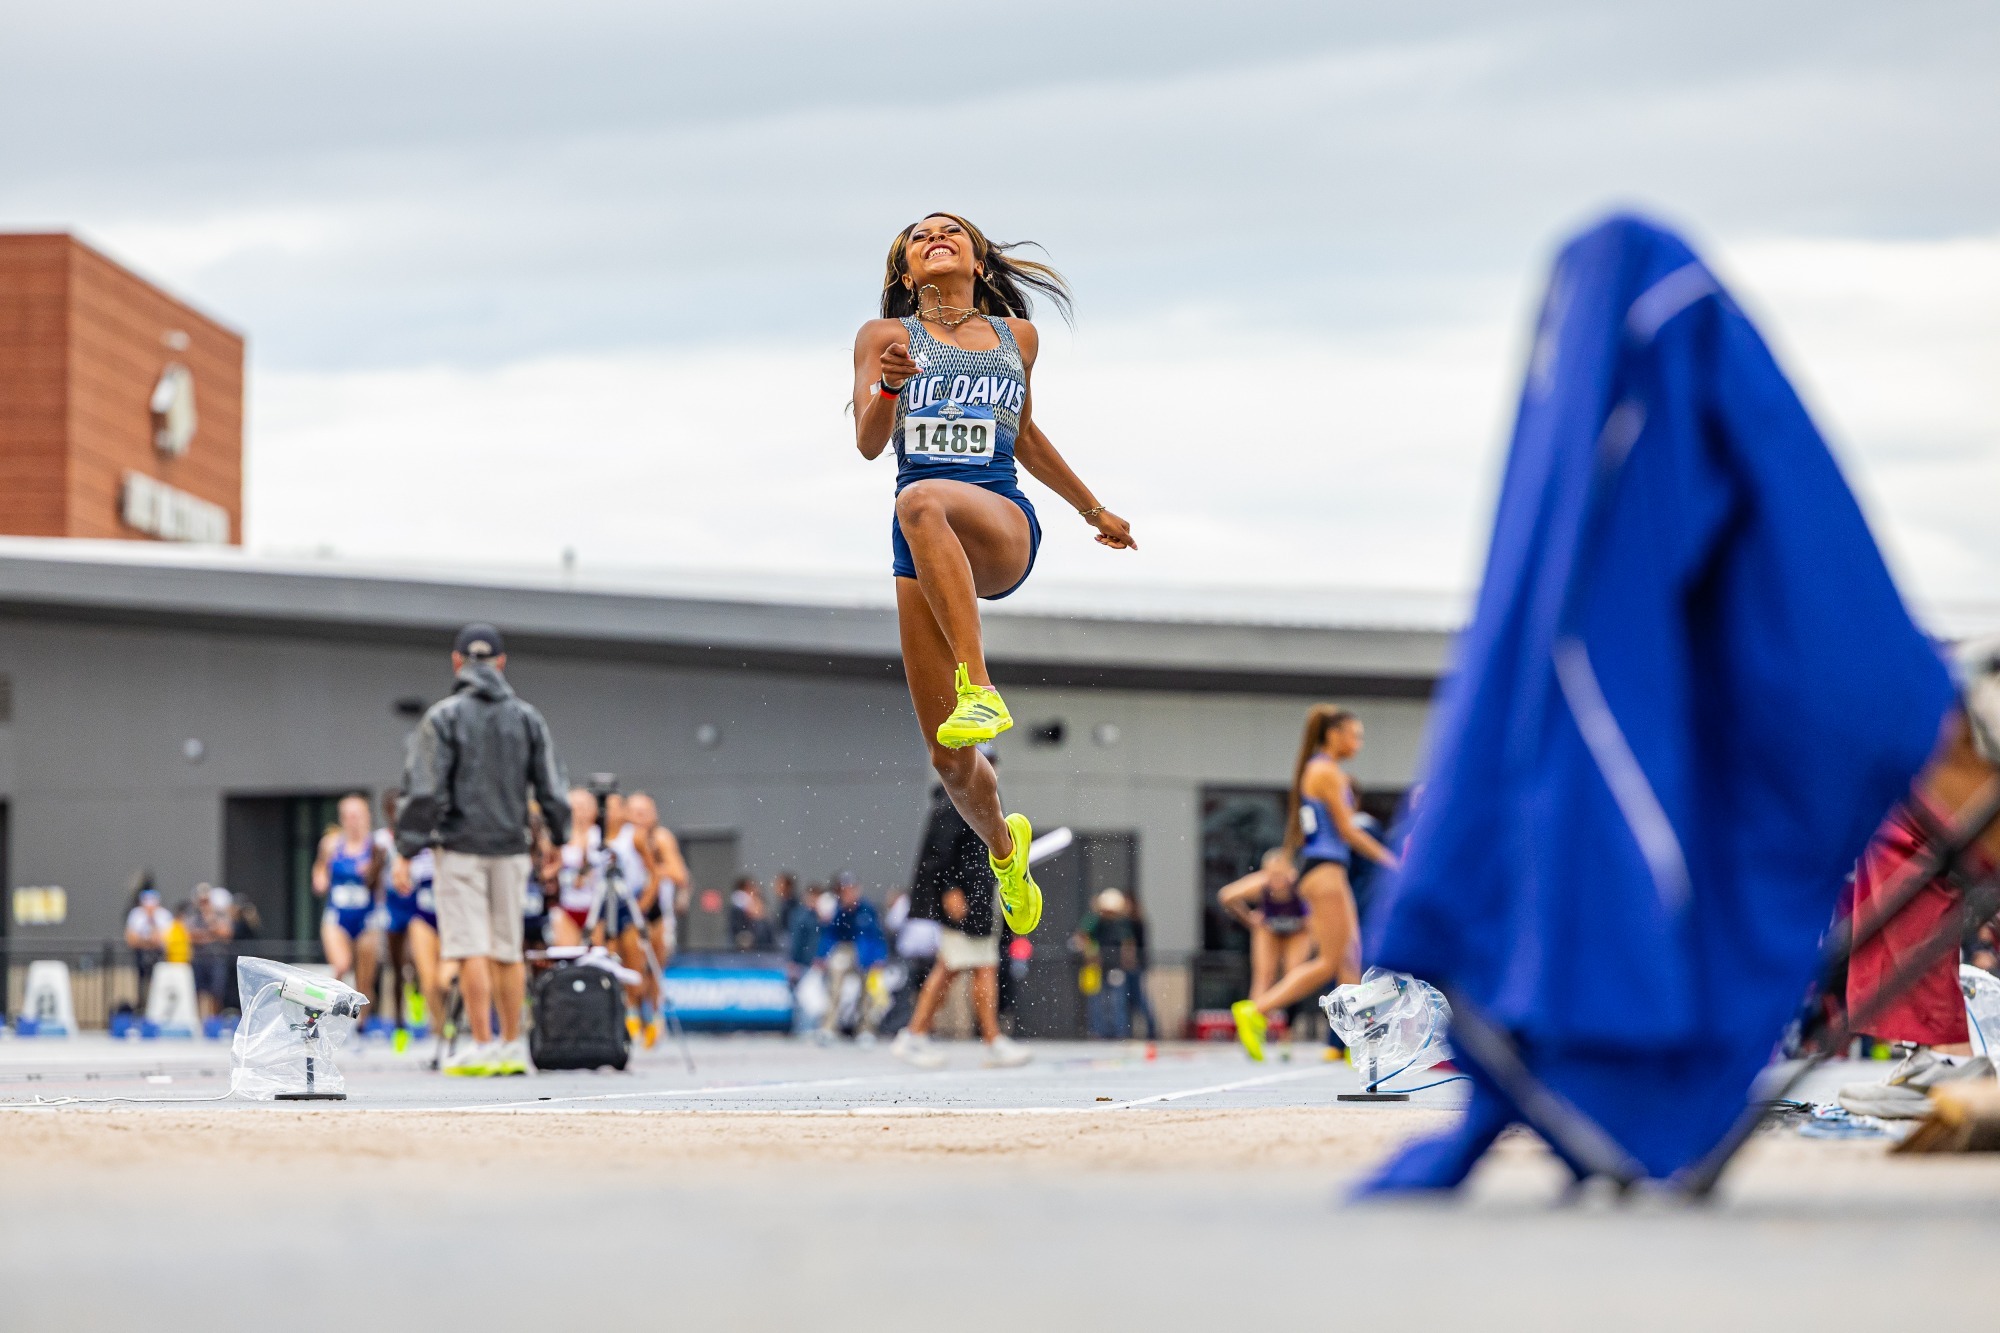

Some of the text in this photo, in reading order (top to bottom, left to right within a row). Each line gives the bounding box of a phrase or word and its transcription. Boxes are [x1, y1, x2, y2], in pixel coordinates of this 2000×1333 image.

[909, 375, 1026, 414] UC DAVIS
[915, 423, 987, 453] 1489
